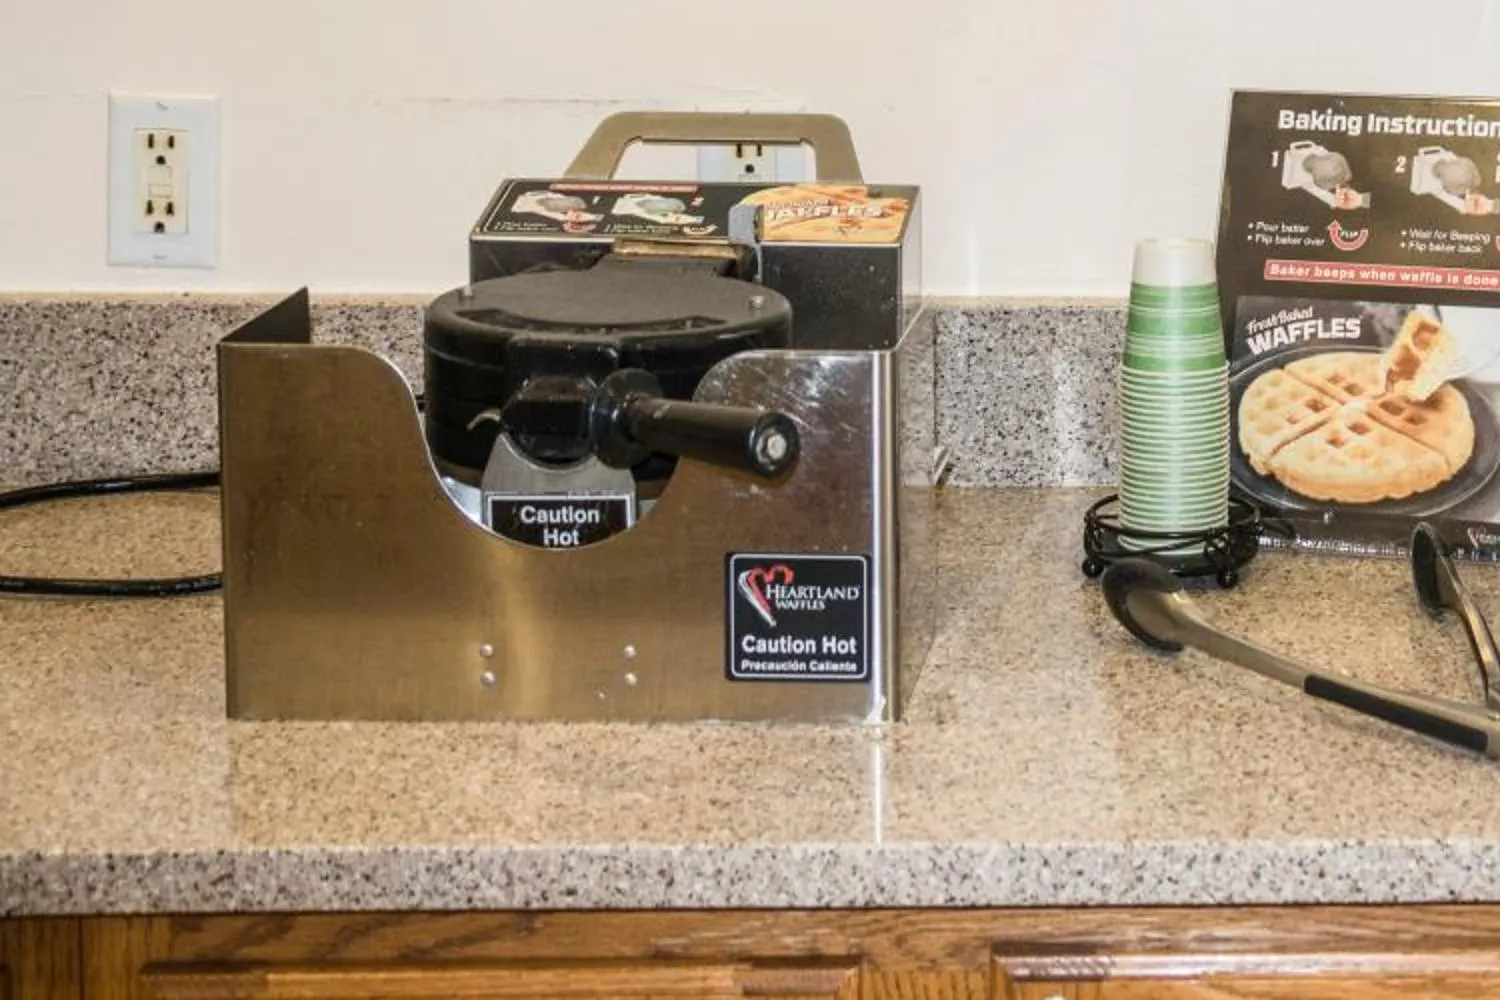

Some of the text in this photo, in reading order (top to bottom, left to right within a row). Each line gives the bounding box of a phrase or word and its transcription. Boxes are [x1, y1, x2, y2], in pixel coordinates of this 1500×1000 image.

[1278, 109, 1362, 136] Baking
[1272, 151, 1279, 168] 1
[1395, 156, 1405, 173] 2
[1303, 236, 1325, 246] over
[1409, 228, 1491, 245] Wait for Beeping
[1269, 263, 1500, 285] Baker beeps when waffle is done
[1247, 316, 1361, 356] WAFFLES
[519, 505, 600, 524] Caution
[543, 527, 580, 546] Hot
[765, 583, 860, 600] HEARTLAND
[775, 599, 826, 611] WAFFLES
[742, 634, 858, 655] Caution Hot
[741, 659, 858, 673] Precaución Caliente
